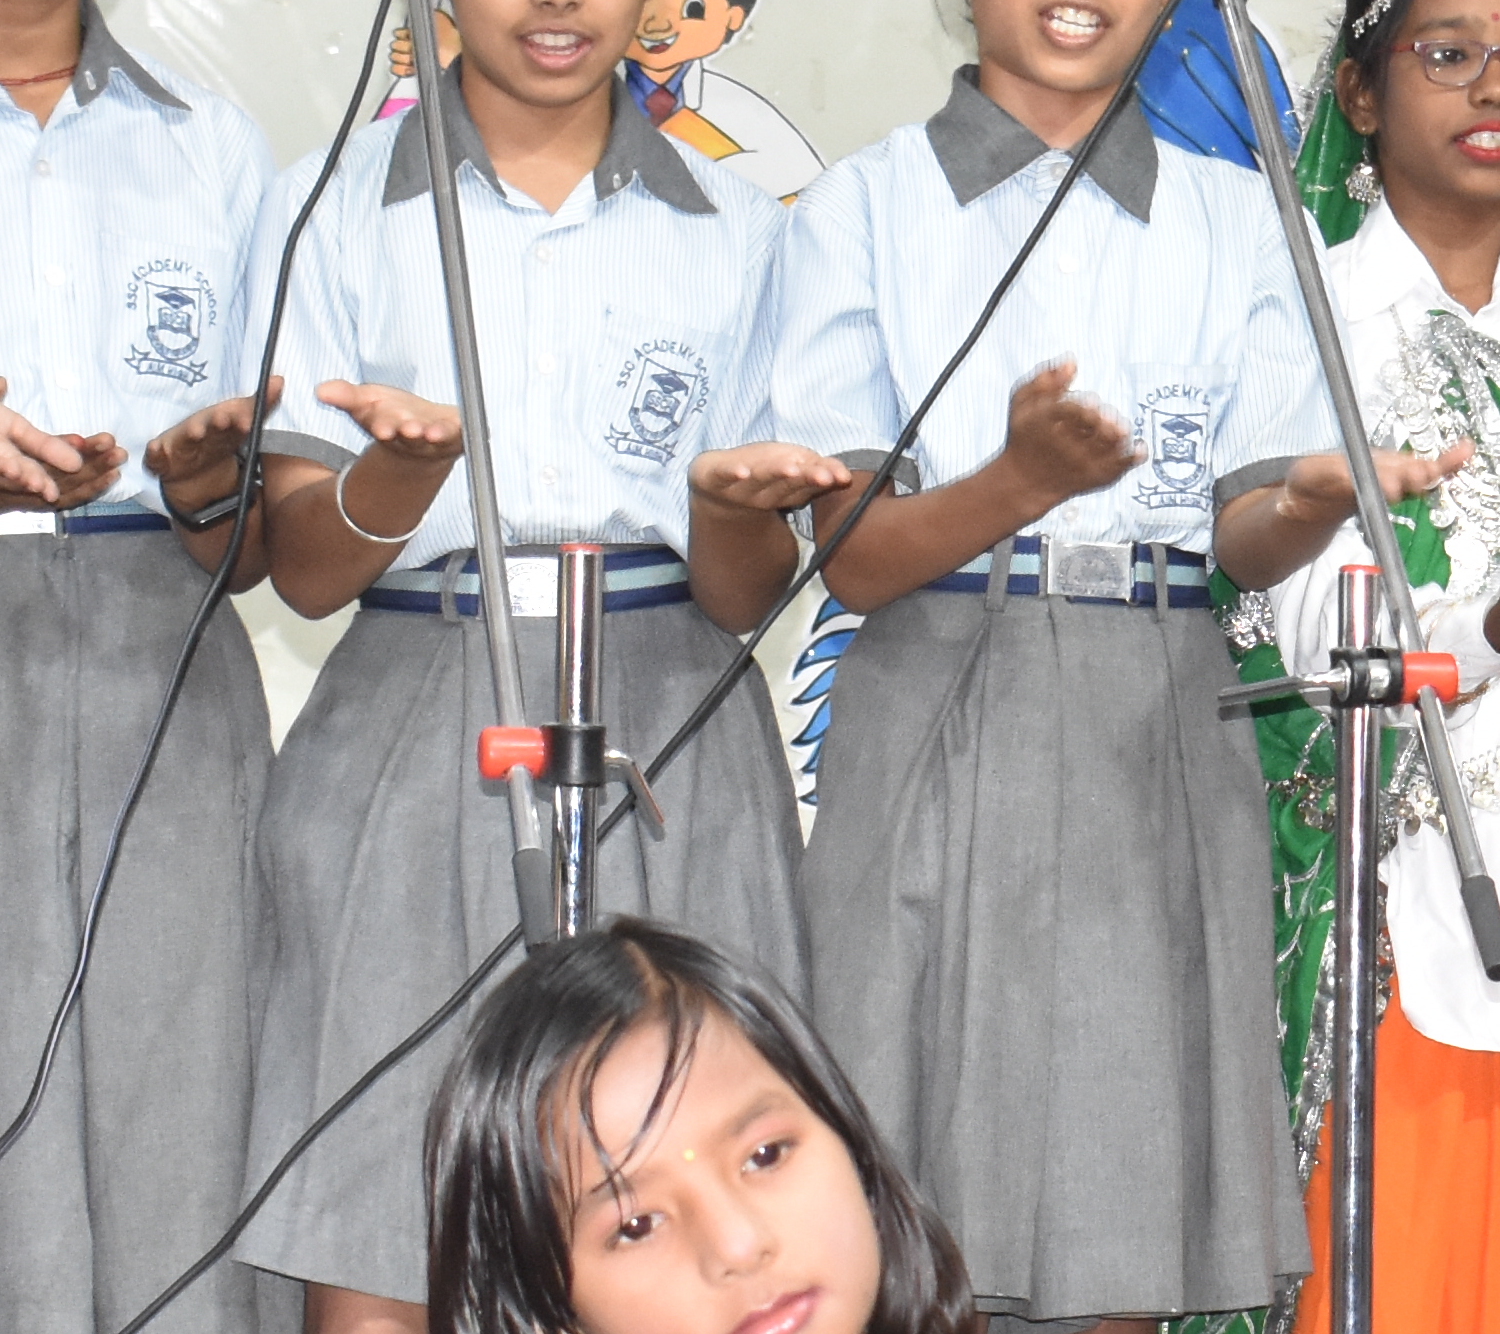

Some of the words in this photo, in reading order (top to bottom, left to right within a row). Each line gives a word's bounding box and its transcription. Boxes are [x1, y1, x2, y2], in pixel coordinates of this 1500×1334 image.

[131, 258, 193, 282] ACADEMY
[126, 281, 139, 311] SSC
[193, 270, 218, 328] SCHOOL
[633, 339, 697, 362] ACADEMY
[690, 356, 710, 415] SCHOOL
[1137, 383, 1203, 414] ACADEMY
[1133, 416, 1145, 447] SSC
